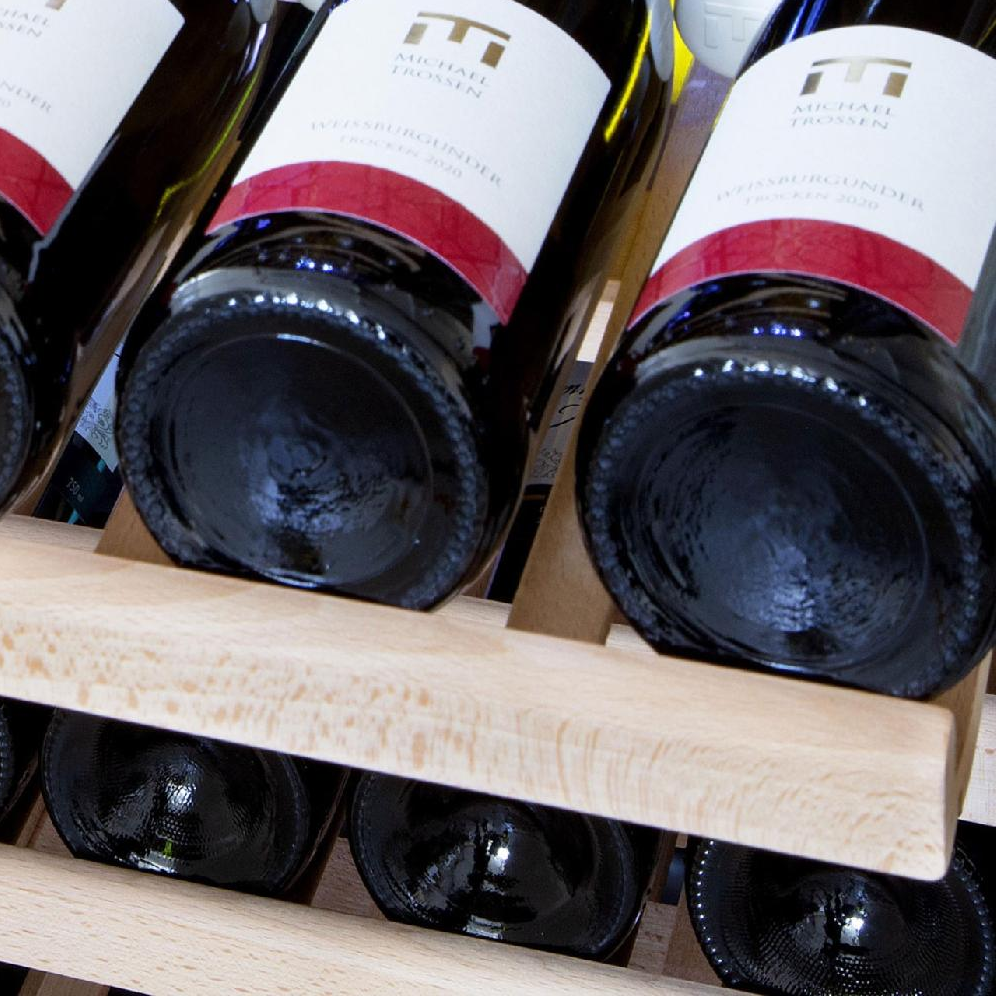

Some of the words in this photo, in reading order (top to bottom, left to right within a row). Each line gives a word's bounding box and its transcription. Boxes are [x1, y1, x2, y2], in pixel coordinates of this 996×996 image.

[391, 64, 483, 98] TROSSEN
[395, 52, 491, 87] MICHAEL
[790, 115, 889, 130] TROSSEN
[793, 102, 894, 117] MICHAEL
[717, 174, 924, 212] WEISSBURGUNDER
